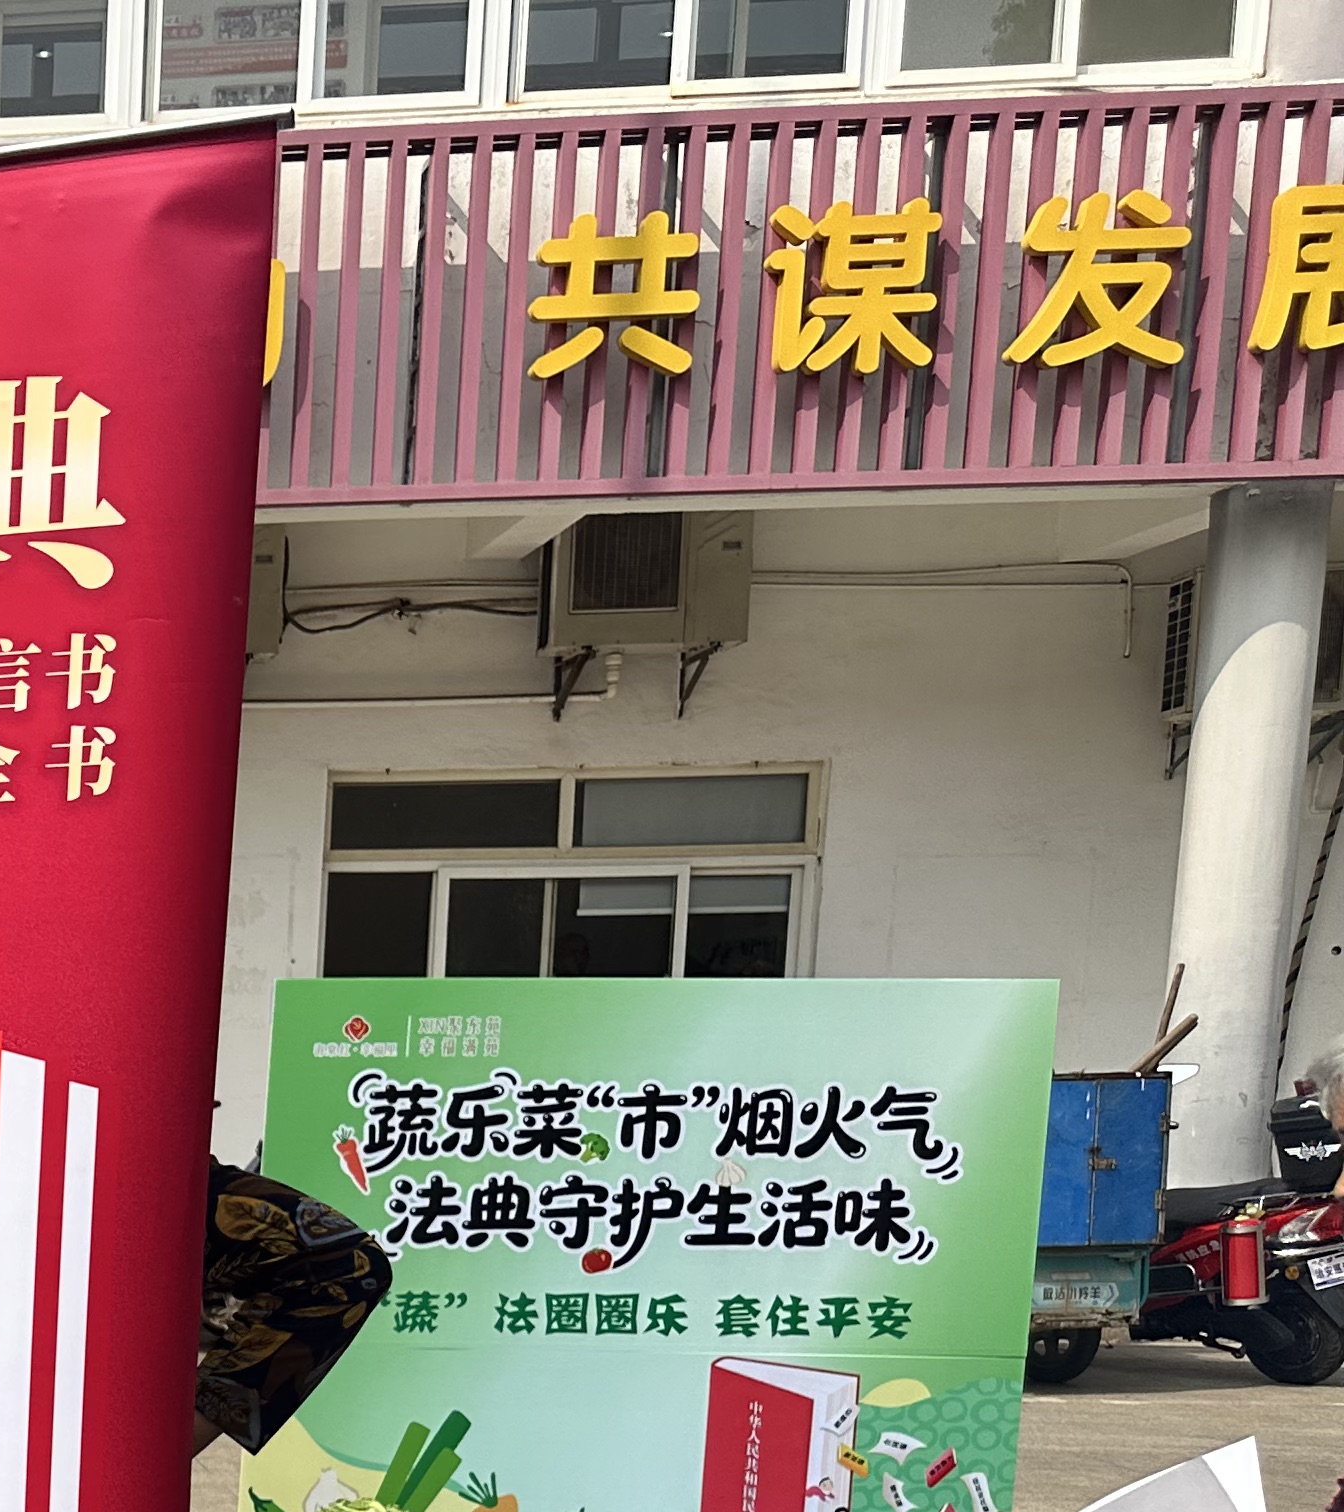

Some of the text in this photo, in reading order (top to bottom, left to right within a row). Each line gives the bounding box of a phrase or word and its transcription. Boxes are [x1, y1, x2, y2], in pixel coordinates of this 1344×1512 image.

[387, 1175, 914, 1269] 法典守护生活味
[494, 1291, 688, 1337] 法圈圈乐
[716, 1294, 913, 1340] 套住平安
